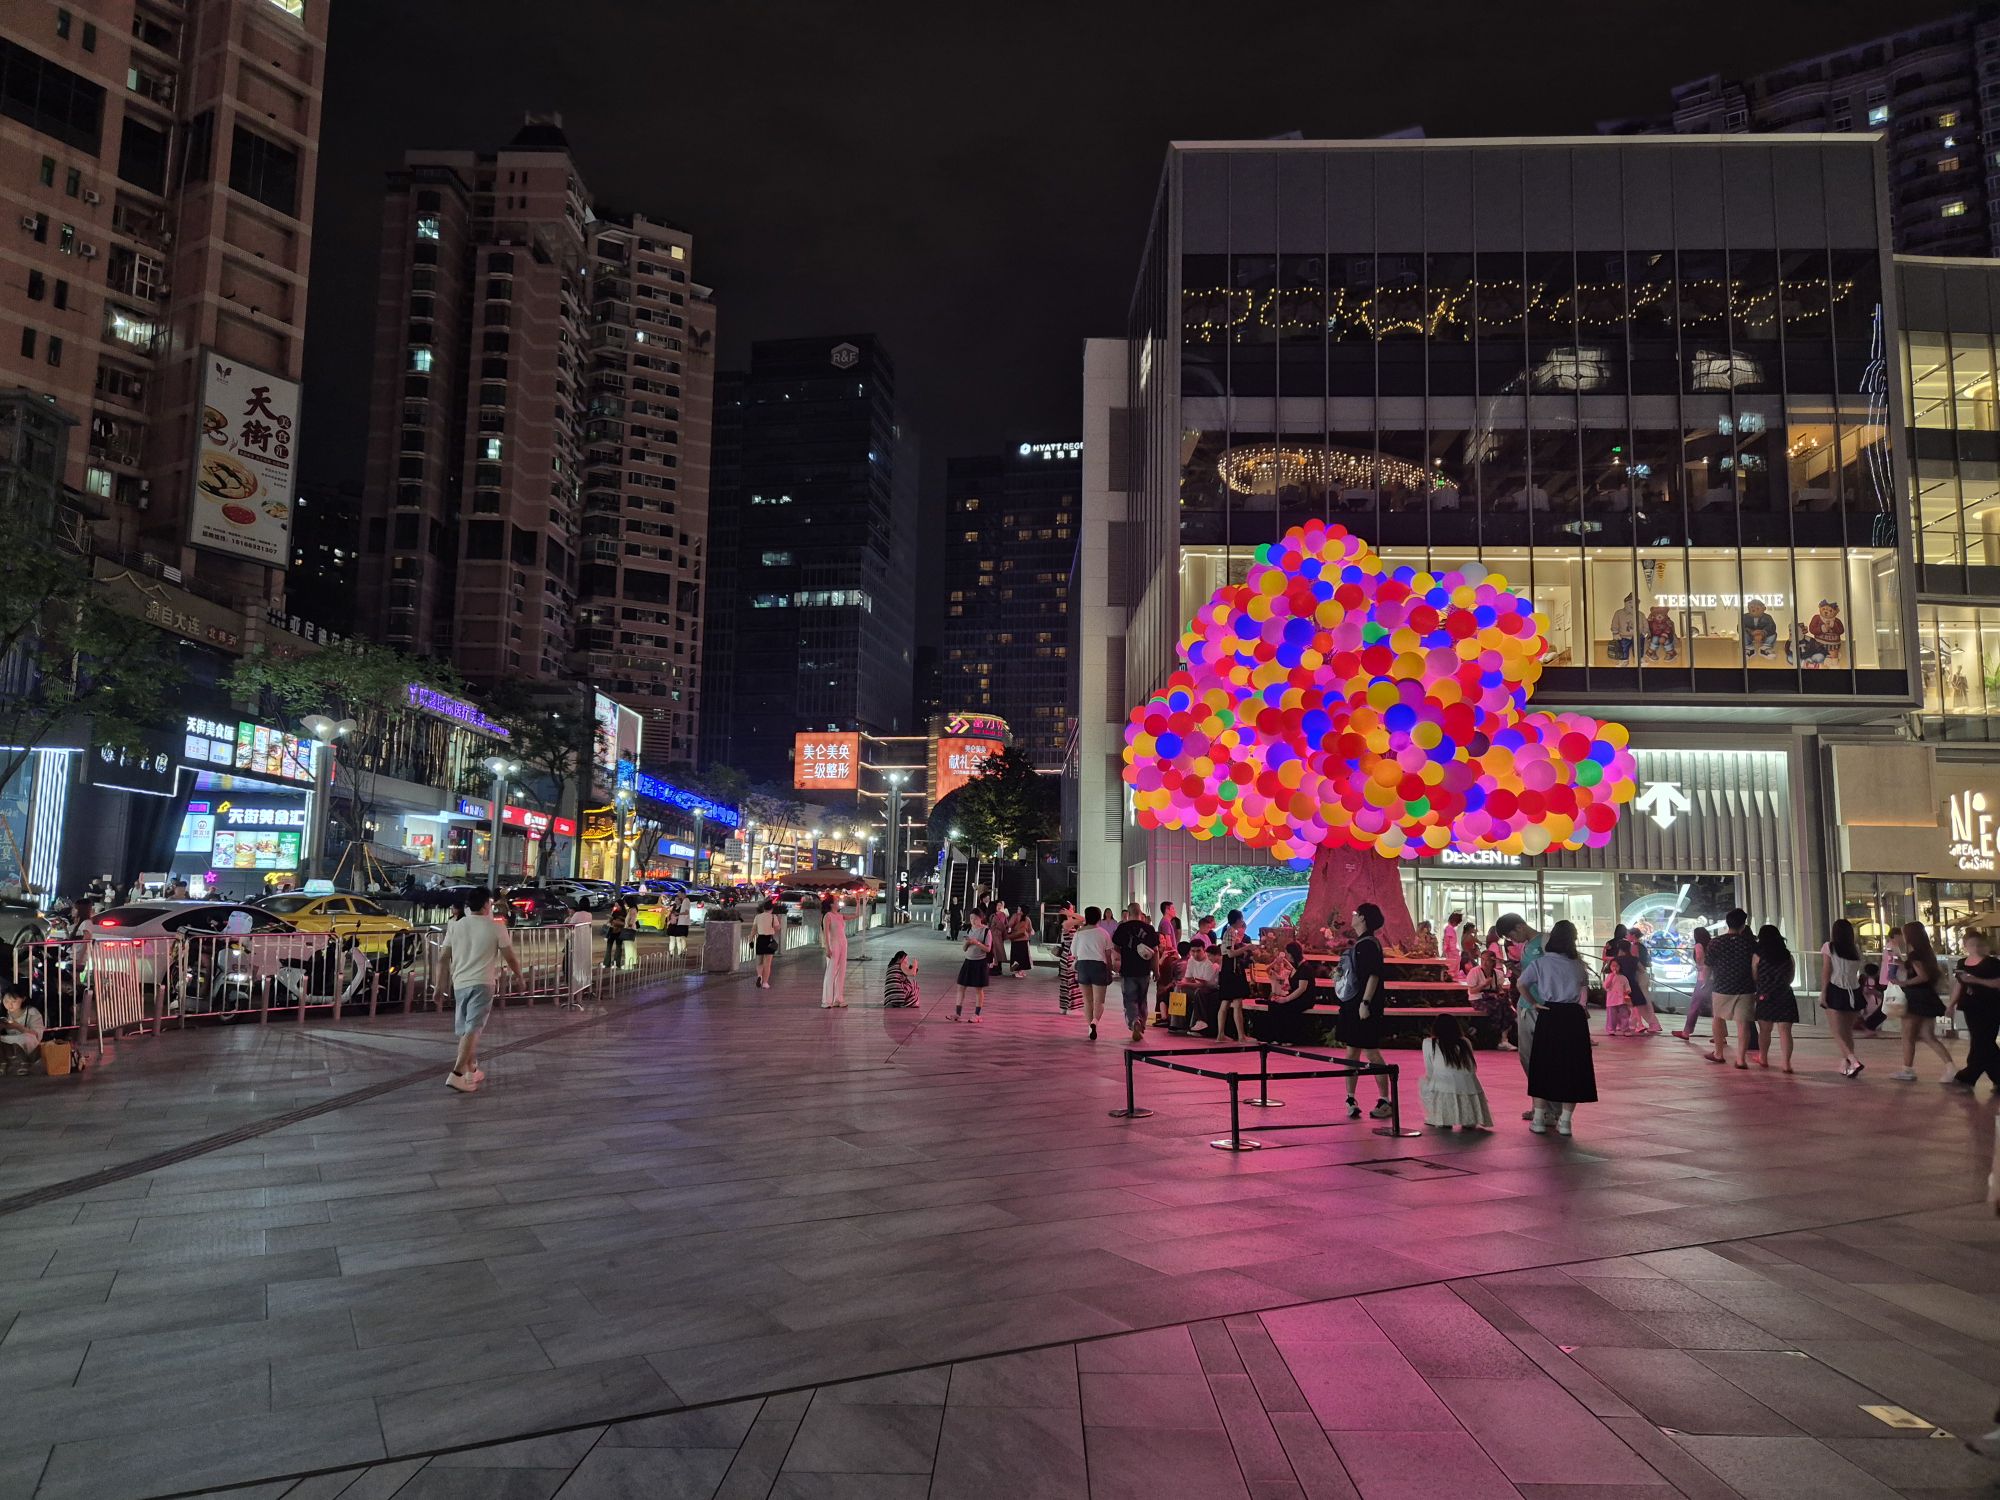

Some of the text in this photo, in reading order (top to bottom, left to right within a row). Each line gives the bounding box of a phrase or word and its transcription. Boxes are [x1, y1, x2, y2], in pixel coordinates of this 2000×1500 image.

[833, 351, 857, 363] R&F
[240, 386, 279, 453] 天街
[1033, 443, 1062, 452] HYATT
[1654, 594, 1717, 607] TEENIE
[146, 601, 200, 636] 源自大连
[803, 744, 850, 760] 美仑美奂
[803, 763, 850, 779] 三级整形
[228, 808, 305, 825] 天街美食汇
